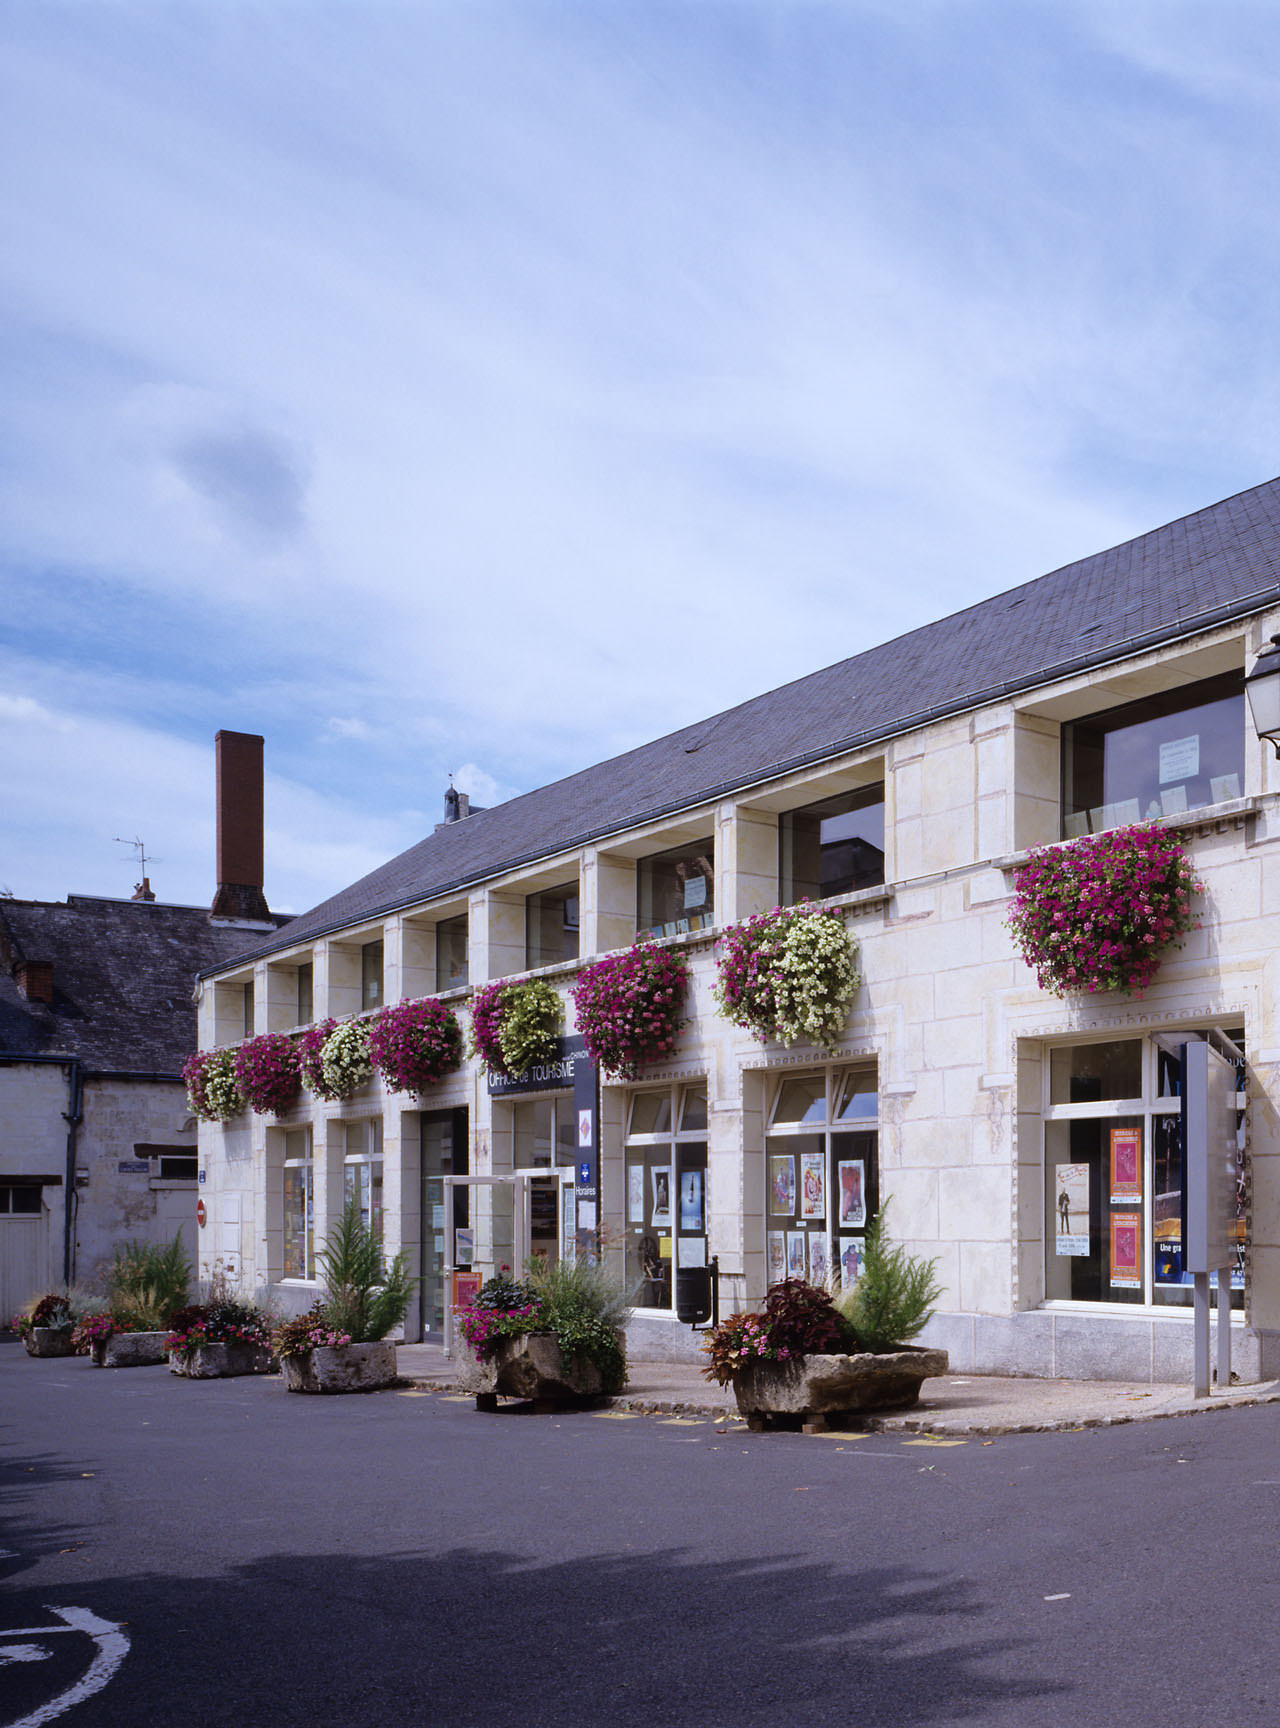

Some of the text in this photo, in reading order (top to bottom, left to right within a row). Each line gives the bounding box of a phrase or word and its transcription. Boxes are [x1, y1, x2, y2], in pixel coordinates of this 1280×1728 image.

[489, 1060, 575, 1087] OFFICE de TOURISME
[575, 1186, 596, 1197] Horaires
[1160, 1243, 1172, 1252] Une
